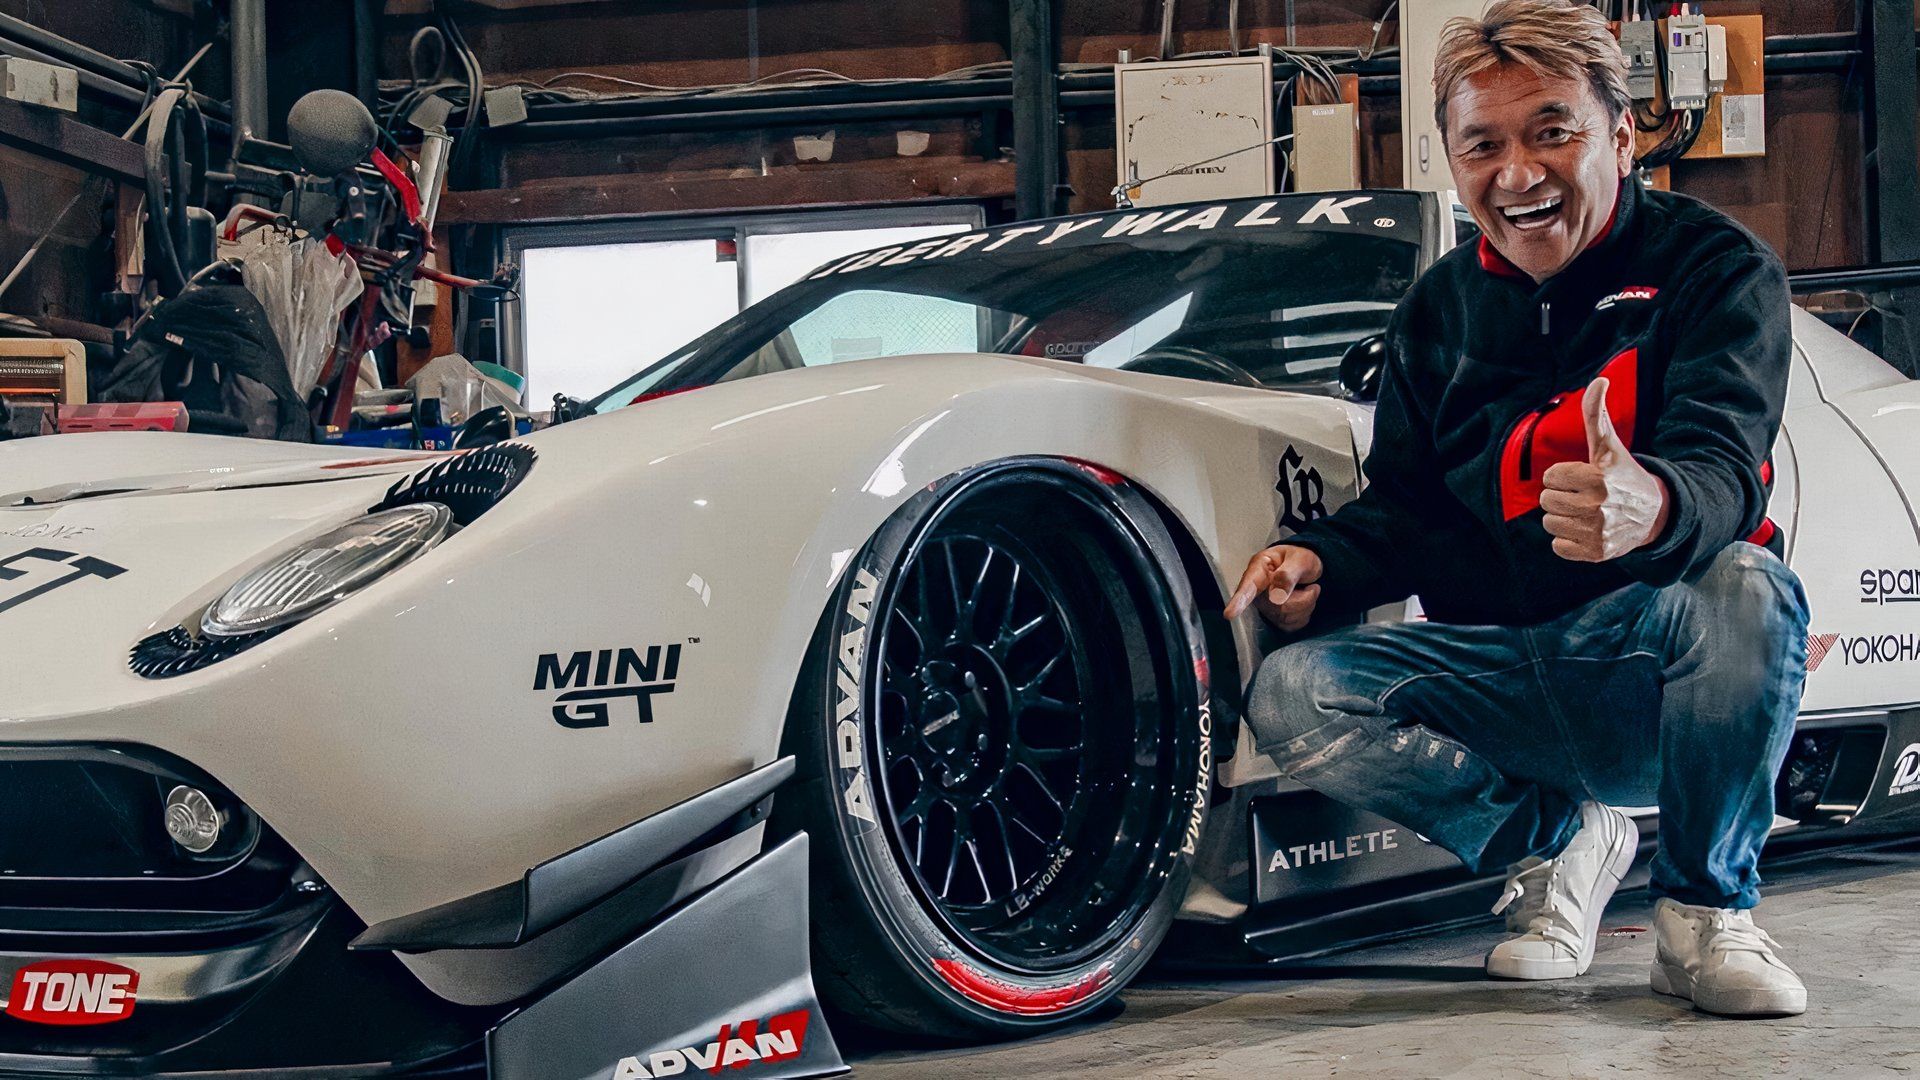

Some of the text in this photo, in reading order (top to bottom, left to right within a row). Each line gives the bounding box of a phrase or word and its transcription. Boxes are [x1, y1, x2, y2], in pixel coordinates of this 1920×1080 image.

[808, 196, 1373, 280] IBERTY WALK
[533, 643, 682, 690] MINI
[552, 683, 675, 729] GT
[836, 567, 880, 829] ADVAN
[1182, 698, 1212, 856] YOKOHAMA
[1268, 828, 1398, 873] ATHLETE
[22, 971, 131, 1014] TONE
[613, 1029, 798, 1080] ADVAN
